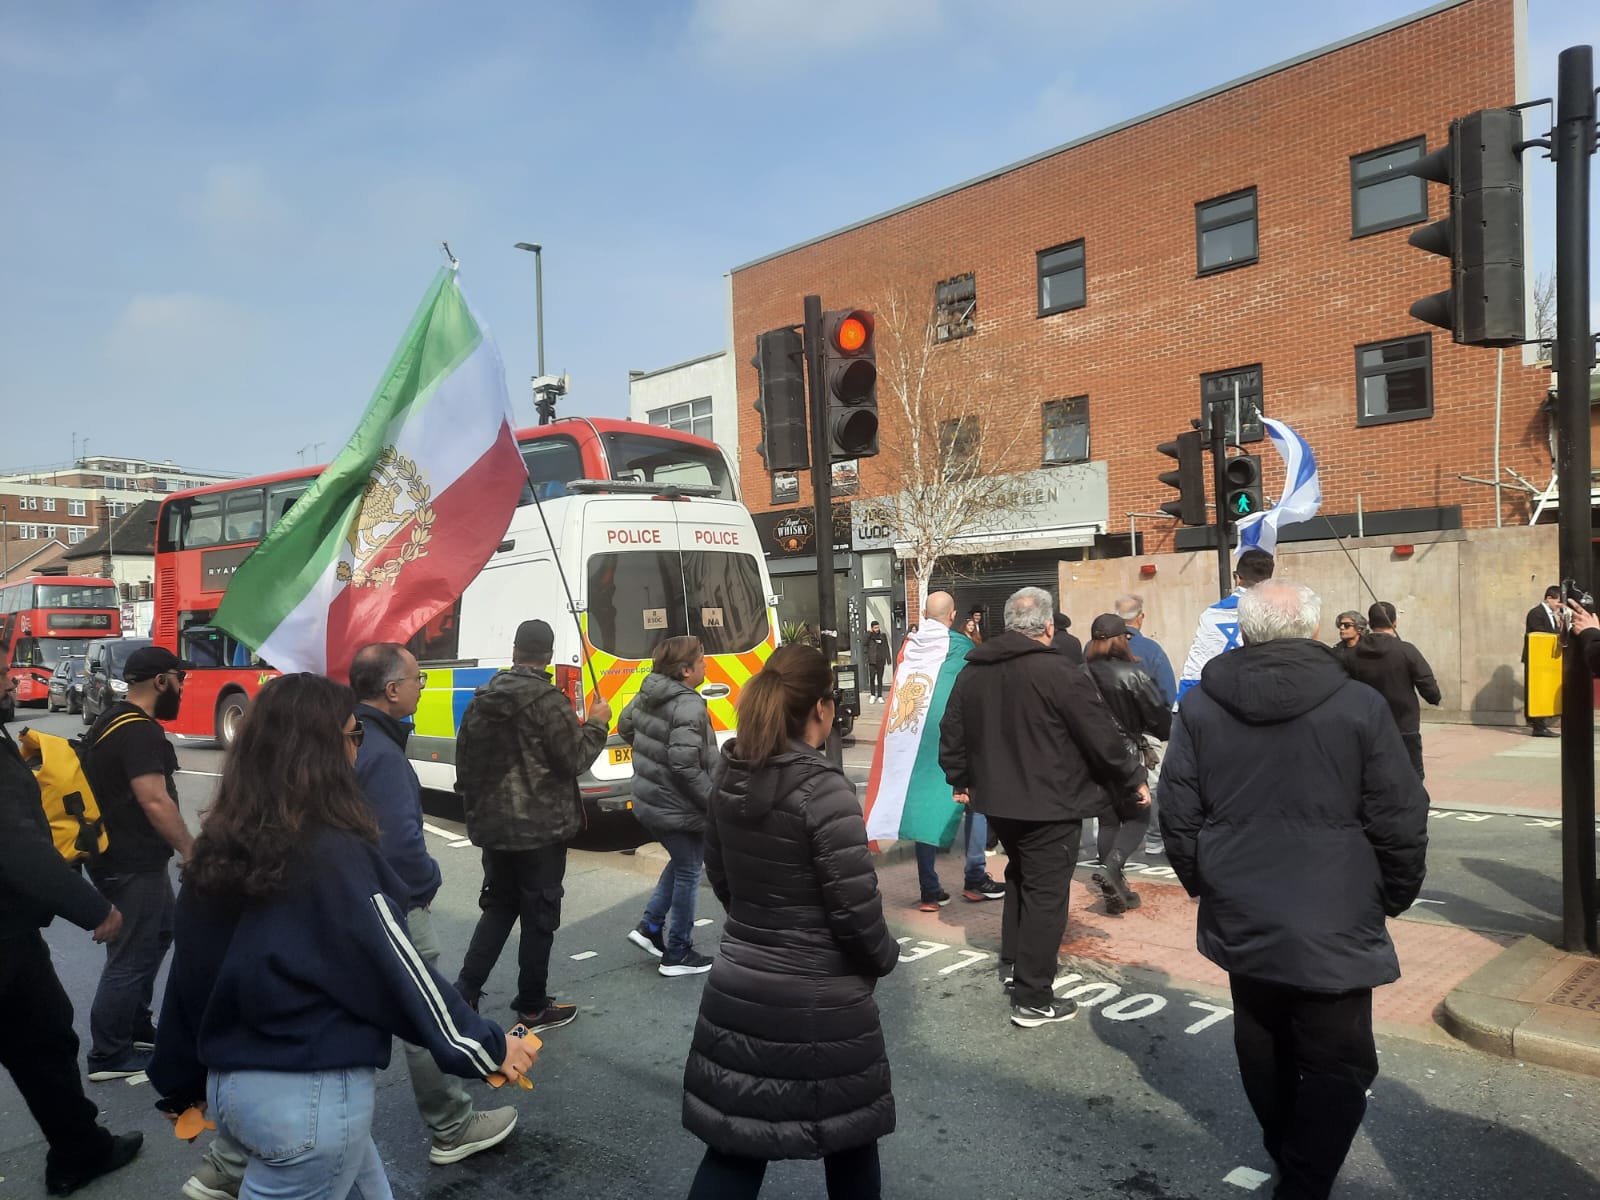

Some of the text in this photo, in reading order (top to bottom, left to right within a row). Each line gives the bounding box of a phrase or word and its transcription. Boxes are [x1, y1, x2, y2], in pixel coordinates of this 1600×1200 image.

[607, 529, 662, 544] POLICE
[777, 524, 808, 537] WHISKY
[695, 530, 740, 545] POLICE
[92, 616, 108, 625] 183
[601, 666, 653, 675] www.met.pol
[615, 748, 633, 762] BX
